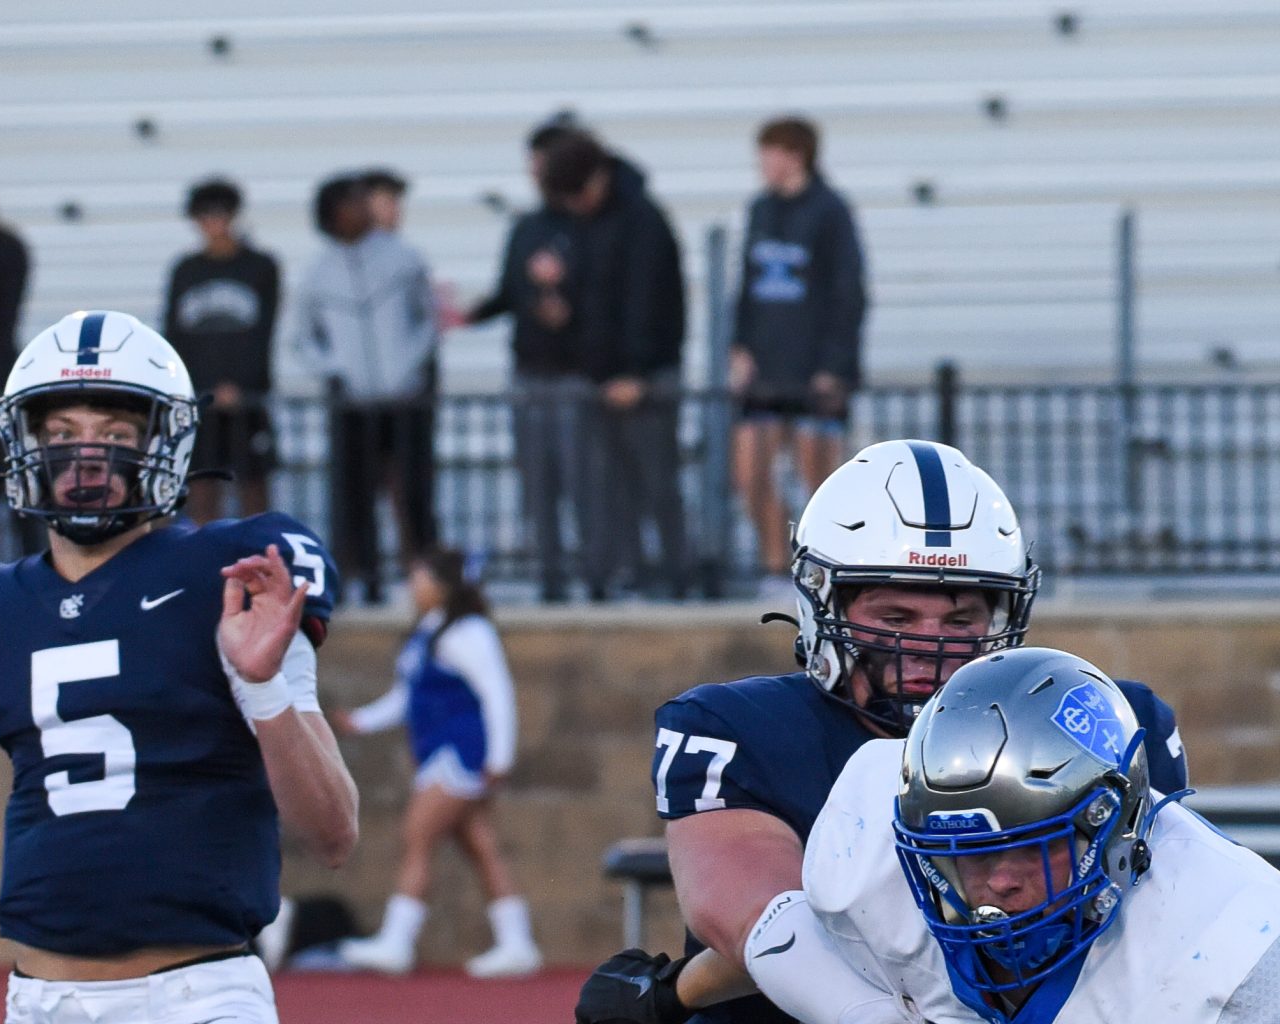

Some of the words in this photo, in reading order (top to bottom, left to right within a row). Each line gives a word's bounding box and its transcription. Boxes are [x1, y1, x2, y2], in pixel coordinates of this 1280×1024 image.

[61, 368, 112, 377] Riddell
[281, 532, 325, 597] 5
[909, 551, 967, 567] Riddell
[31, 639, 136, 816] 5
[656, 727, 737, 813] 77
[929, 818, 981, 831] CATHOLIC
